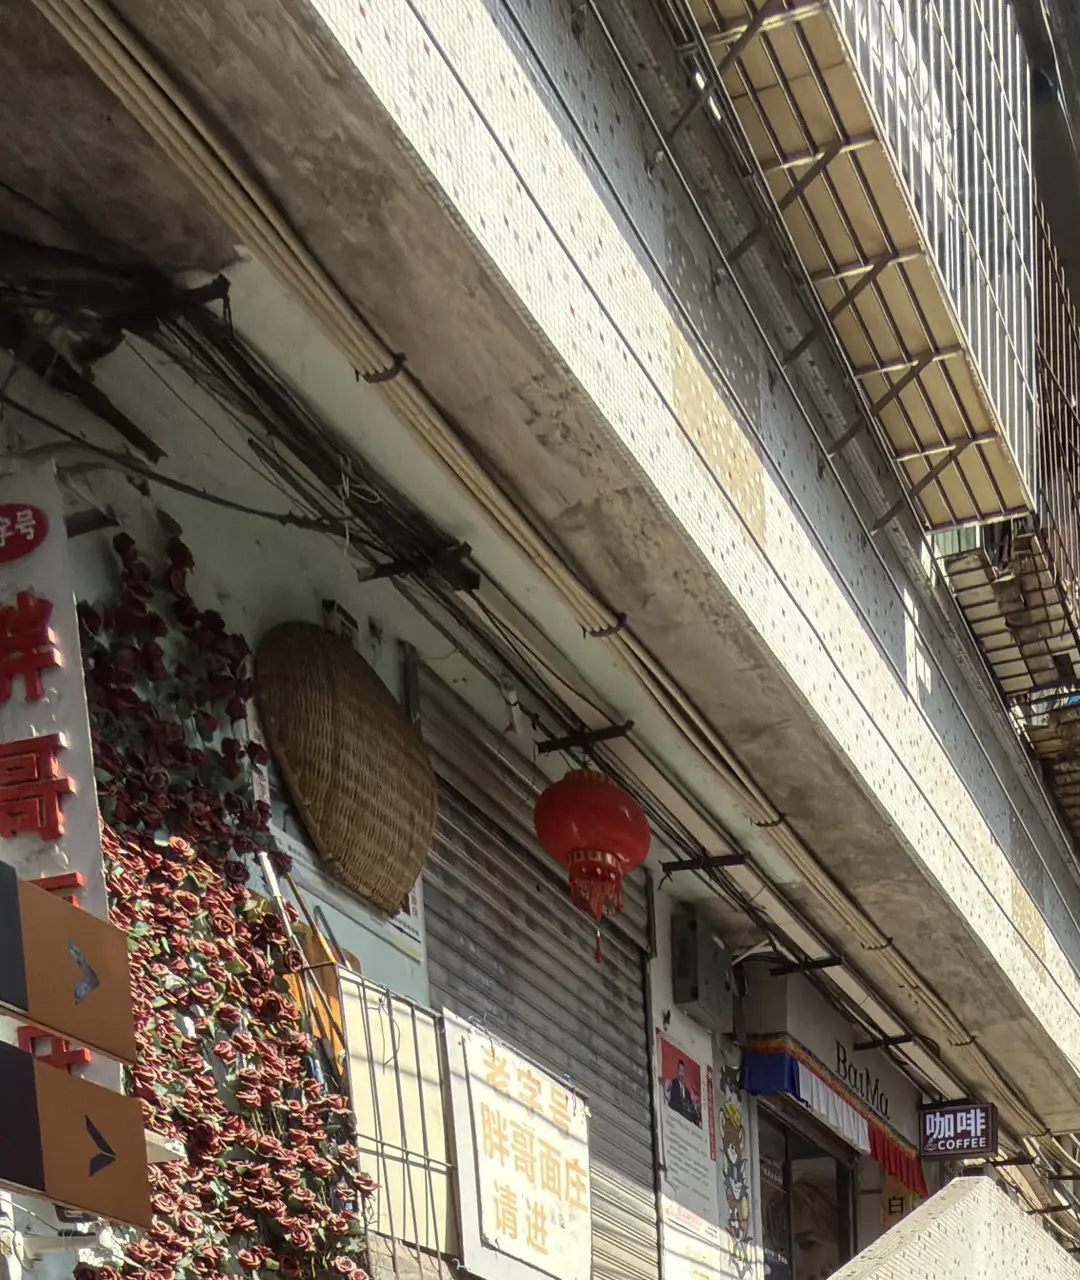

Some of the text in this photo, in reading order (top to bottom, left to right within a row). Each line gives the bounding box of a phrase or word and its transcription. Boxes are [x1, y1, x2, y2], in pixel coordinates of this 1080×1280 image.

[482, 1047, 572, 1139] 老字号
[925, 1108, 986, 1138] 咖啡
[480, 1101, 589, 1213] 胖哥面庄
[937, 1137, 987, 1150] COFFEE
[493, 1179, 549, 1255] 请进
